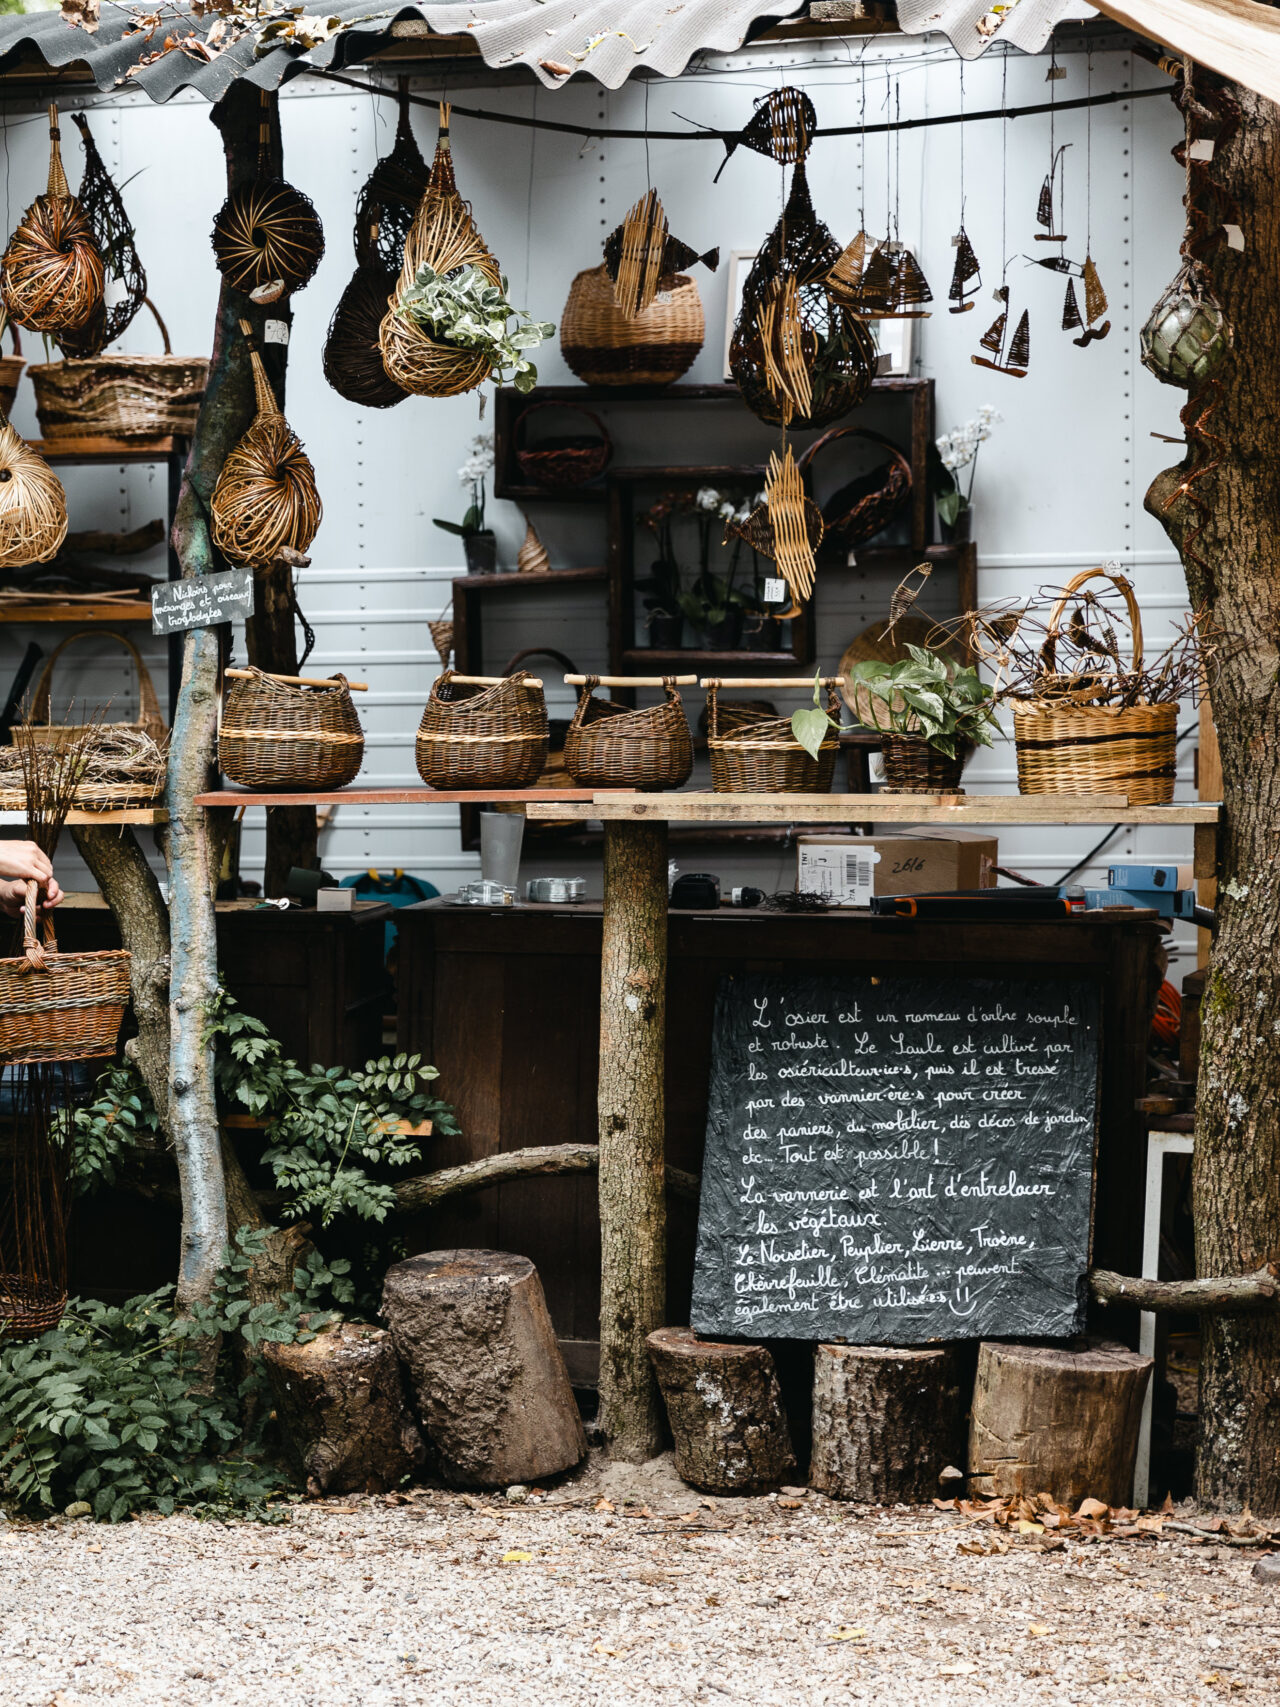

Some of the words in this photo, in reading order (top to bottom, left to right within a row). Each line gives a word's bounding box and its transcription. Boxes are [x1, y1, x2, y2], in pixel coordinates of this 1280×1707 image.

[155, 601, 196, 615] mésanges
[199, 594, 212, 607] et
[217, 590, 250, 603] oiseaux
[173, 585, 208, 601] Nichoirs
[212, 582, 233, 596] pour
[168, 607, 222, 626] troglodytes
[838, 1001, 863, 1023] est
[876, 1014, 899, 1023] un
[905, 1012, 961, 1023] rameau
[967, 1003, 1017, 1023] d'arbre
[1025, 1005, 1079, 1028] souple
[748, 1036, 764, 1052] et
[854, 1031, 878, 1054] Le
[890, 1032, 944, 1055] Saule
[952, 1035, 976, 1054] est
[983, 1034, 1038, 1053] cultivé
[1044, 1043, 1074, 1058] par
[748, 1062, 768, 1080] les
[925, 1063, 955, 1080] puis
[961, 1058, 980, 1075] il
[985, 1060, 1007, 1076] est
[1015, 1058, 1060, 1076] tressé
[745, 1098, 775, 1118] par
[781, 1090, 805, 1107] des
[934, 1089, 974, 1109] pour
[982, 1082, 1026, 1101] créer
[743, 1123, 767, 1140] des
[777, 1122, 840, 1144] paniers,
[846, 1119, 867, 1132] du
[871, 1109, 946, 1134] mobilier,
[978, 1113, 1016, 1129] décos
[1025, 1110, 1040, 1125] de
[779, 1144, 817, 1163] Tout
[824, 1144, 844, 1161] est
[740, 1175, 766, 1203] La
[773, 1186, 849, 1203] vannerie
[858, 1178, 879, 1199] est
[890, 1174, 937, 1198] l'art
[945, 1170, 1056, 1197] d'entrelacer
[756, 1209, 778, 1234] les
[788, 1205, 887, 1237] végétaux.
[736, 1244, 755, 1266] Le
[760, 1239, 836, 1263] Noisetier,
[840, 1233, 909, 1263] Peuplier,
[912, 1228, 973, 1255] Lierre,
[970, 1225, 1034, 1249] Troène,
[955, 1256, 1022, 1283] peuvent
[734, 1293, 819, 1323] également
[829, 1291, 864, 1311] être
